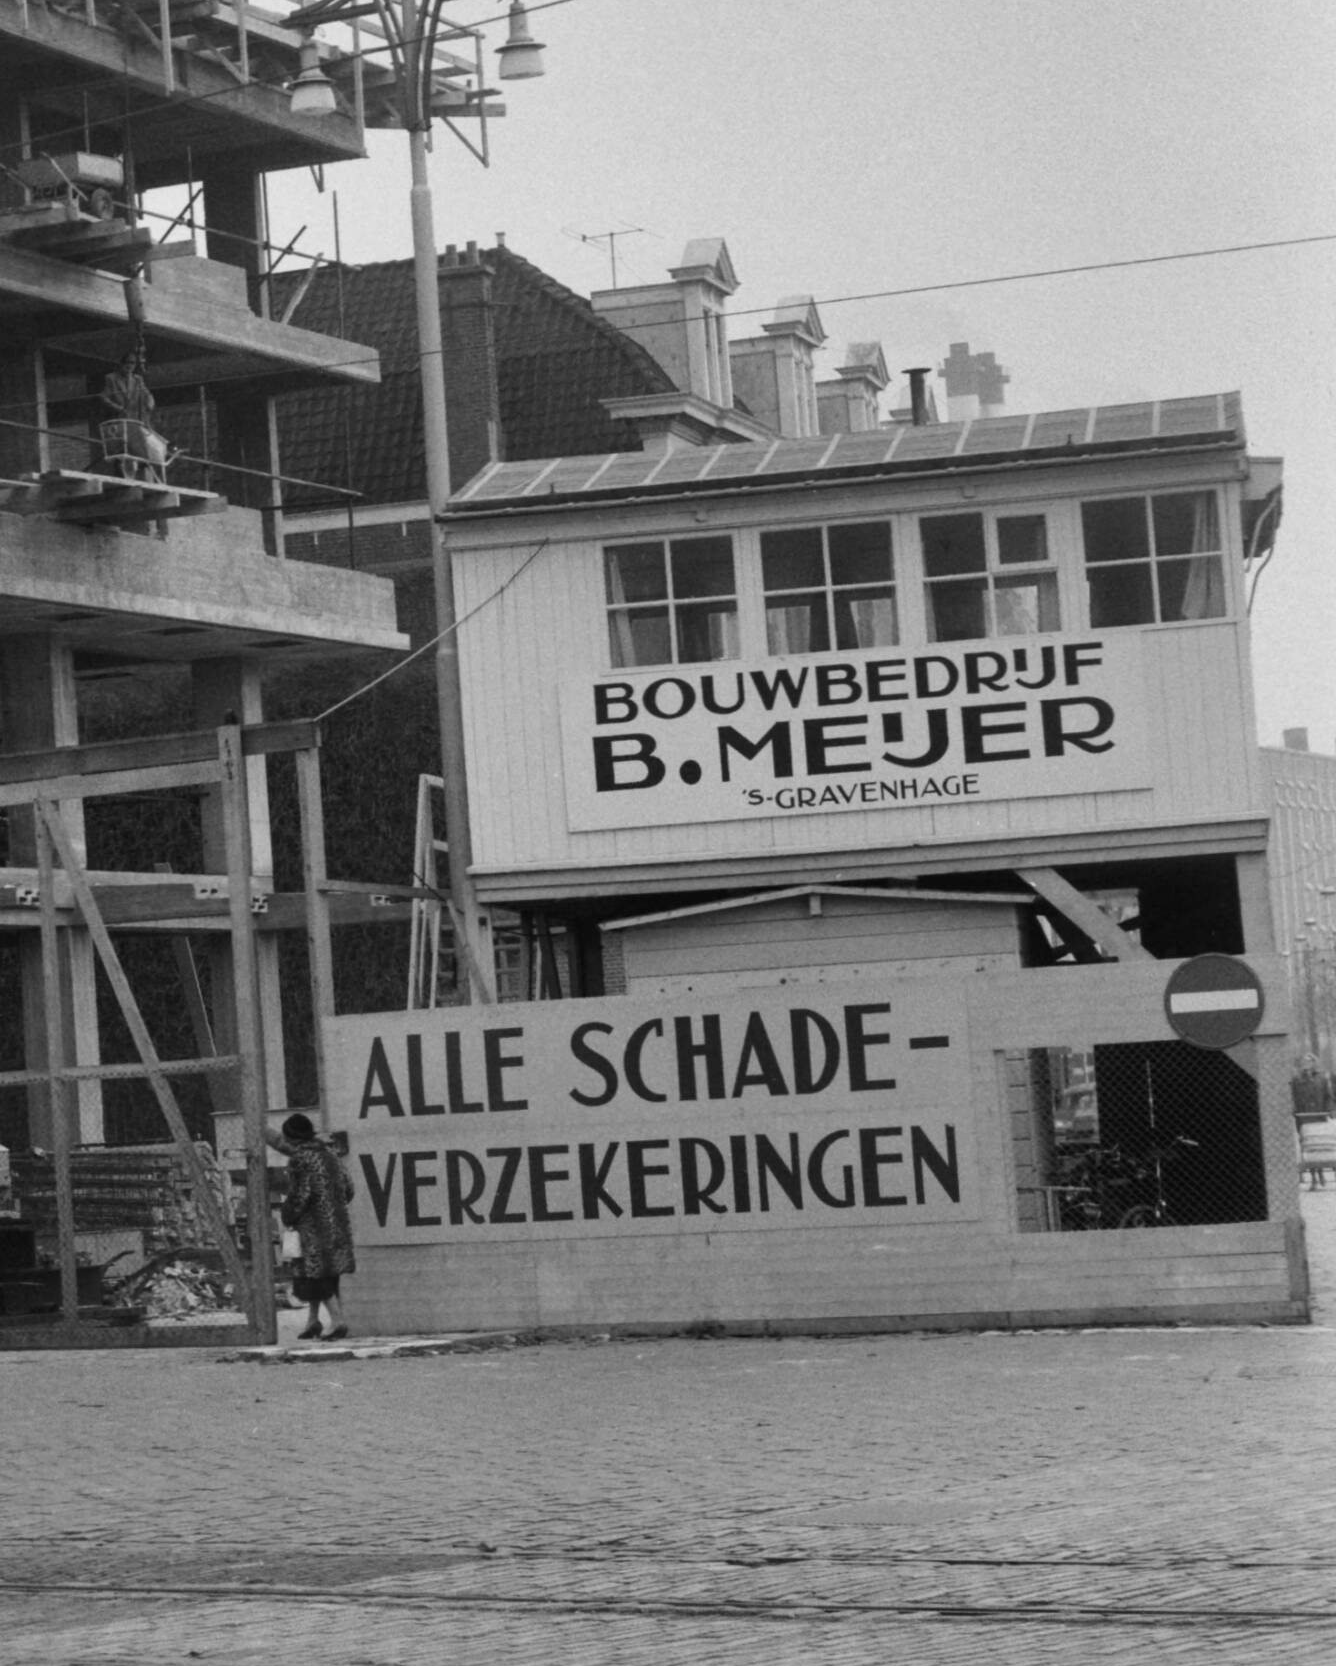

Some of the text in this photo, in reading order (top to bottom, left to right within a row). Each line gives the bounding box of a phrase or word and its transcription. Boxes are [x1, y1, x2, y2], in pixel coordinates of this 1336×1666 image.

[592, 641, 1104, 725] BOUWBEDRIJF
[358, 1026, 529, 1120] ALLE
[358, 1123, 962, 1229] VERZEKERINGEN
